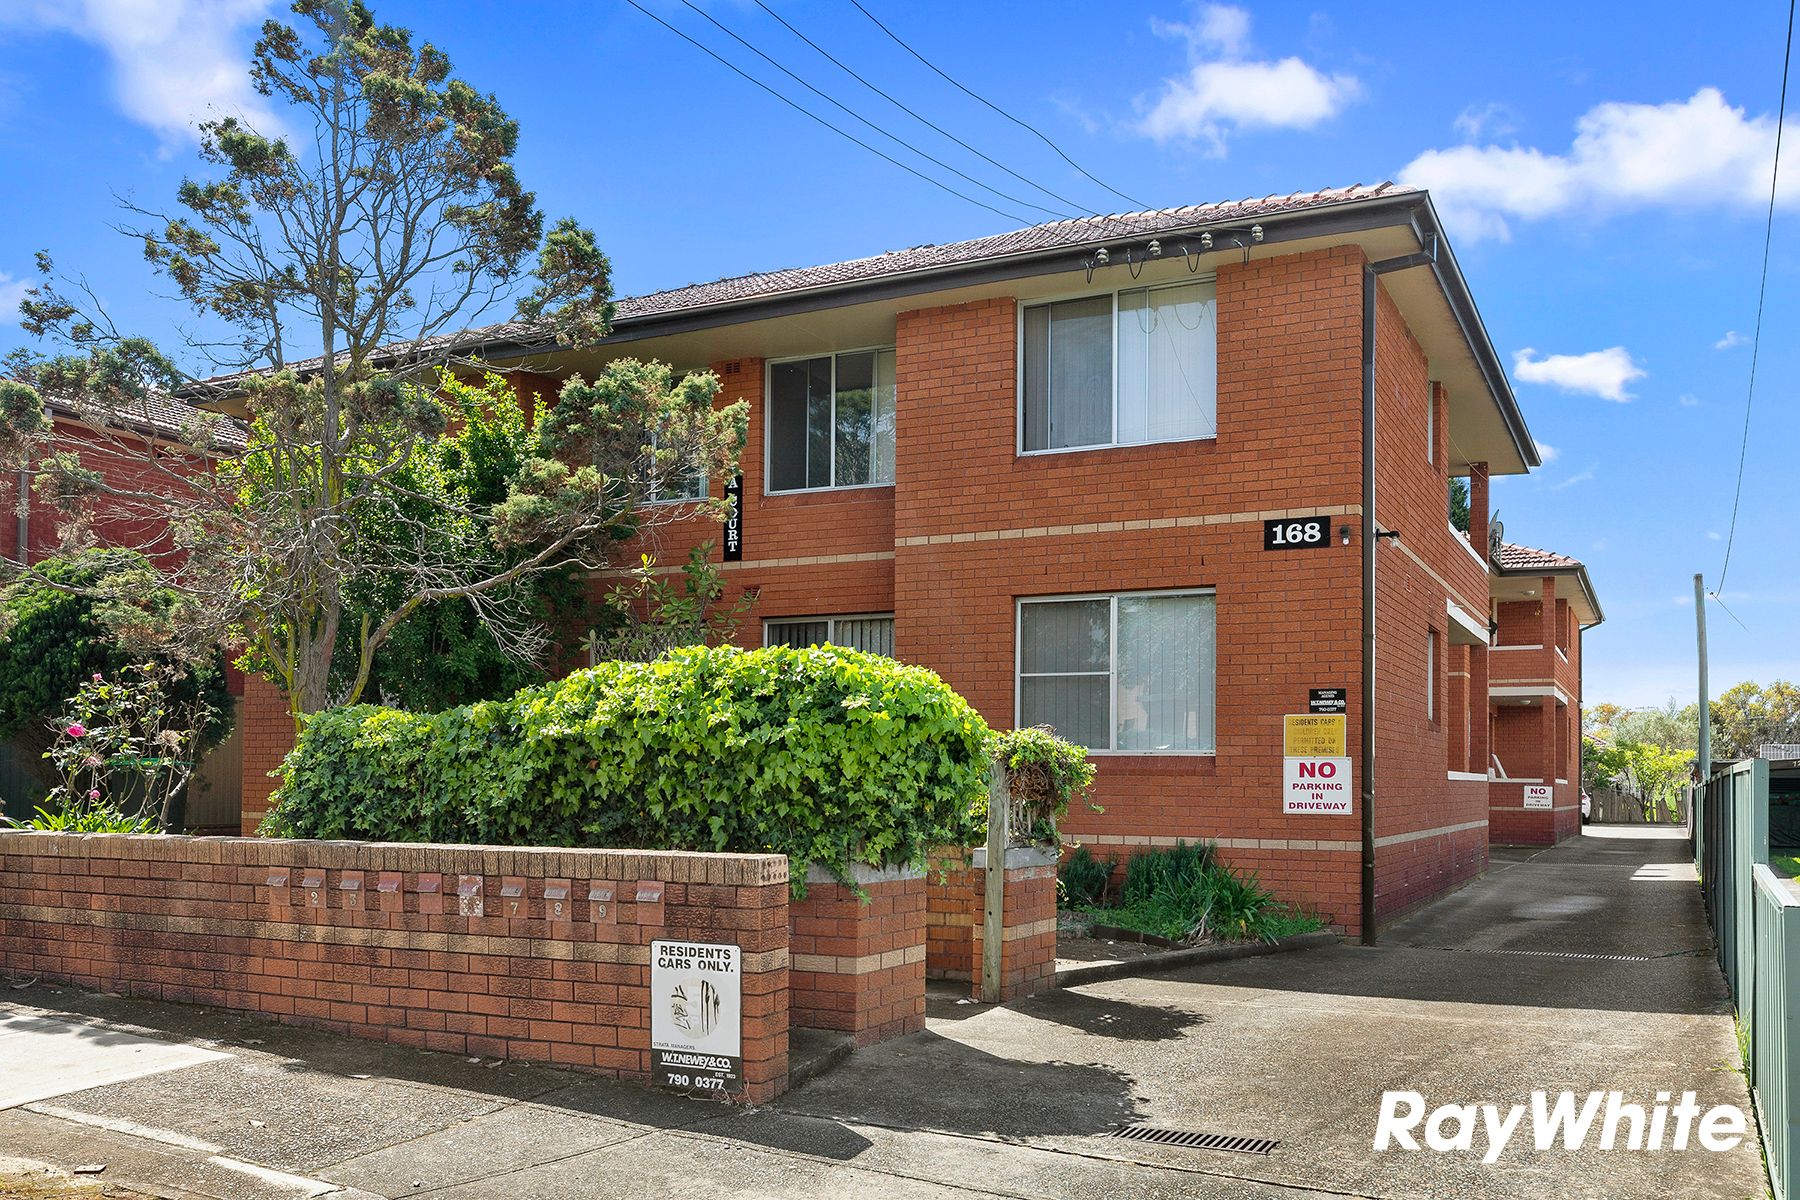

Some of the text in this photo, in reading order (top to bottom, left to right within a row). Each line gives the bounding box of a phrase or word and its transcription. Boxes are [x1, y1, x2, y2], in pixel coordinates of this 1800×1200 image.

[1272, 522, 1321, 544] 168
[1288, 718, 1318, 726] ESIDENTS
[1298, 762, 1337, 778] NO
[311, 891, 319, 904] 2
[510, 902, 519, 915] 7
[660, 945, 731, 960] RESIDENTS
[658, 958, 734, 972] CARS ONLY.
[667, 1073, 724, 1089] 790 0377
